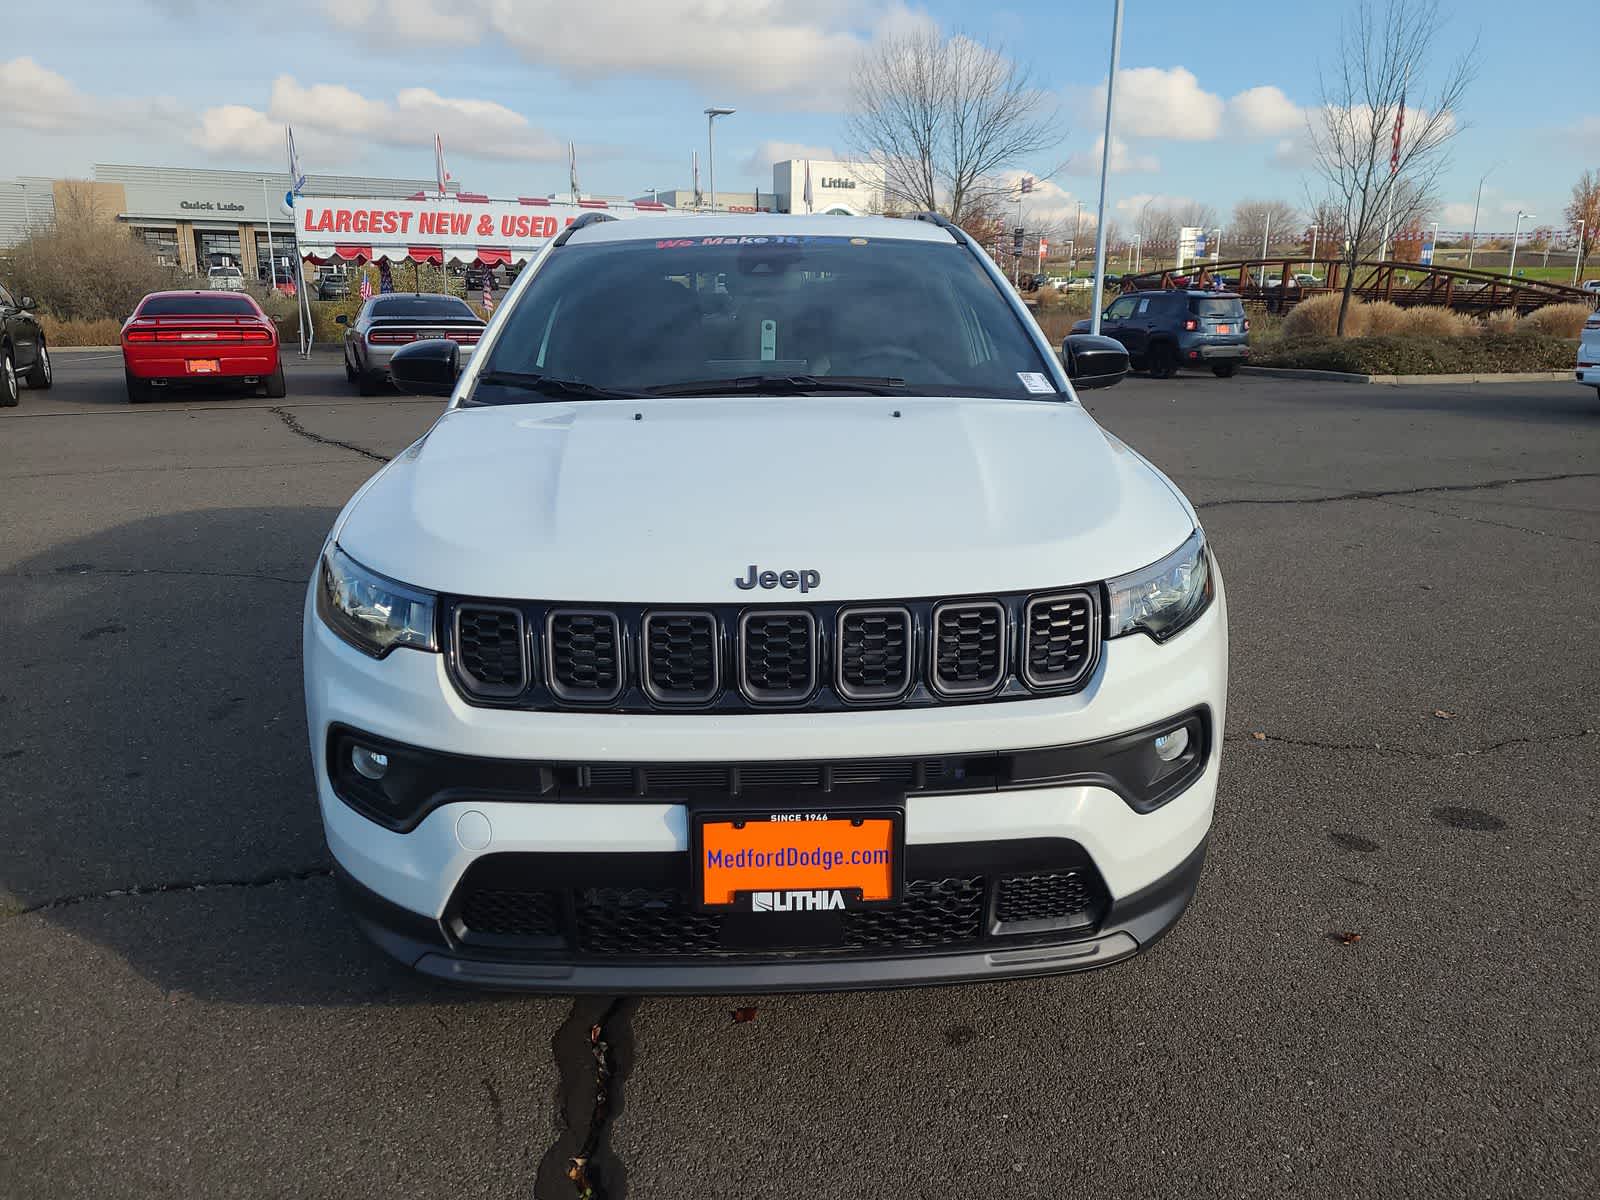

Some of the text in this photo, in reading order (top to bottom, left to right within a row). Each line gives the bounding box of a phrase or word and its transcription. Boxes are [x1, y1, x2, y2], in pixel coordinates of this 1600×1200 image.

[821, 177, 856, 189] Lithia
[180, 200, 245, 211] Quick Lube
[304, 208, 413, 235] LARGEST
[418, 212, 473, 236] NEW
[477, 214, 494, 237] &
[501, 214, 558, 238] USED
[656, 239, 695, 249] We
[701, 235, 770, 246] Make
[734, 564, 821, 593] Jeep
[770, 813, 829, 822] SINCE 1946
[707, 847, 889, 870] MedfordDodge.com
[773, 889, 846, 911] LITHIA
